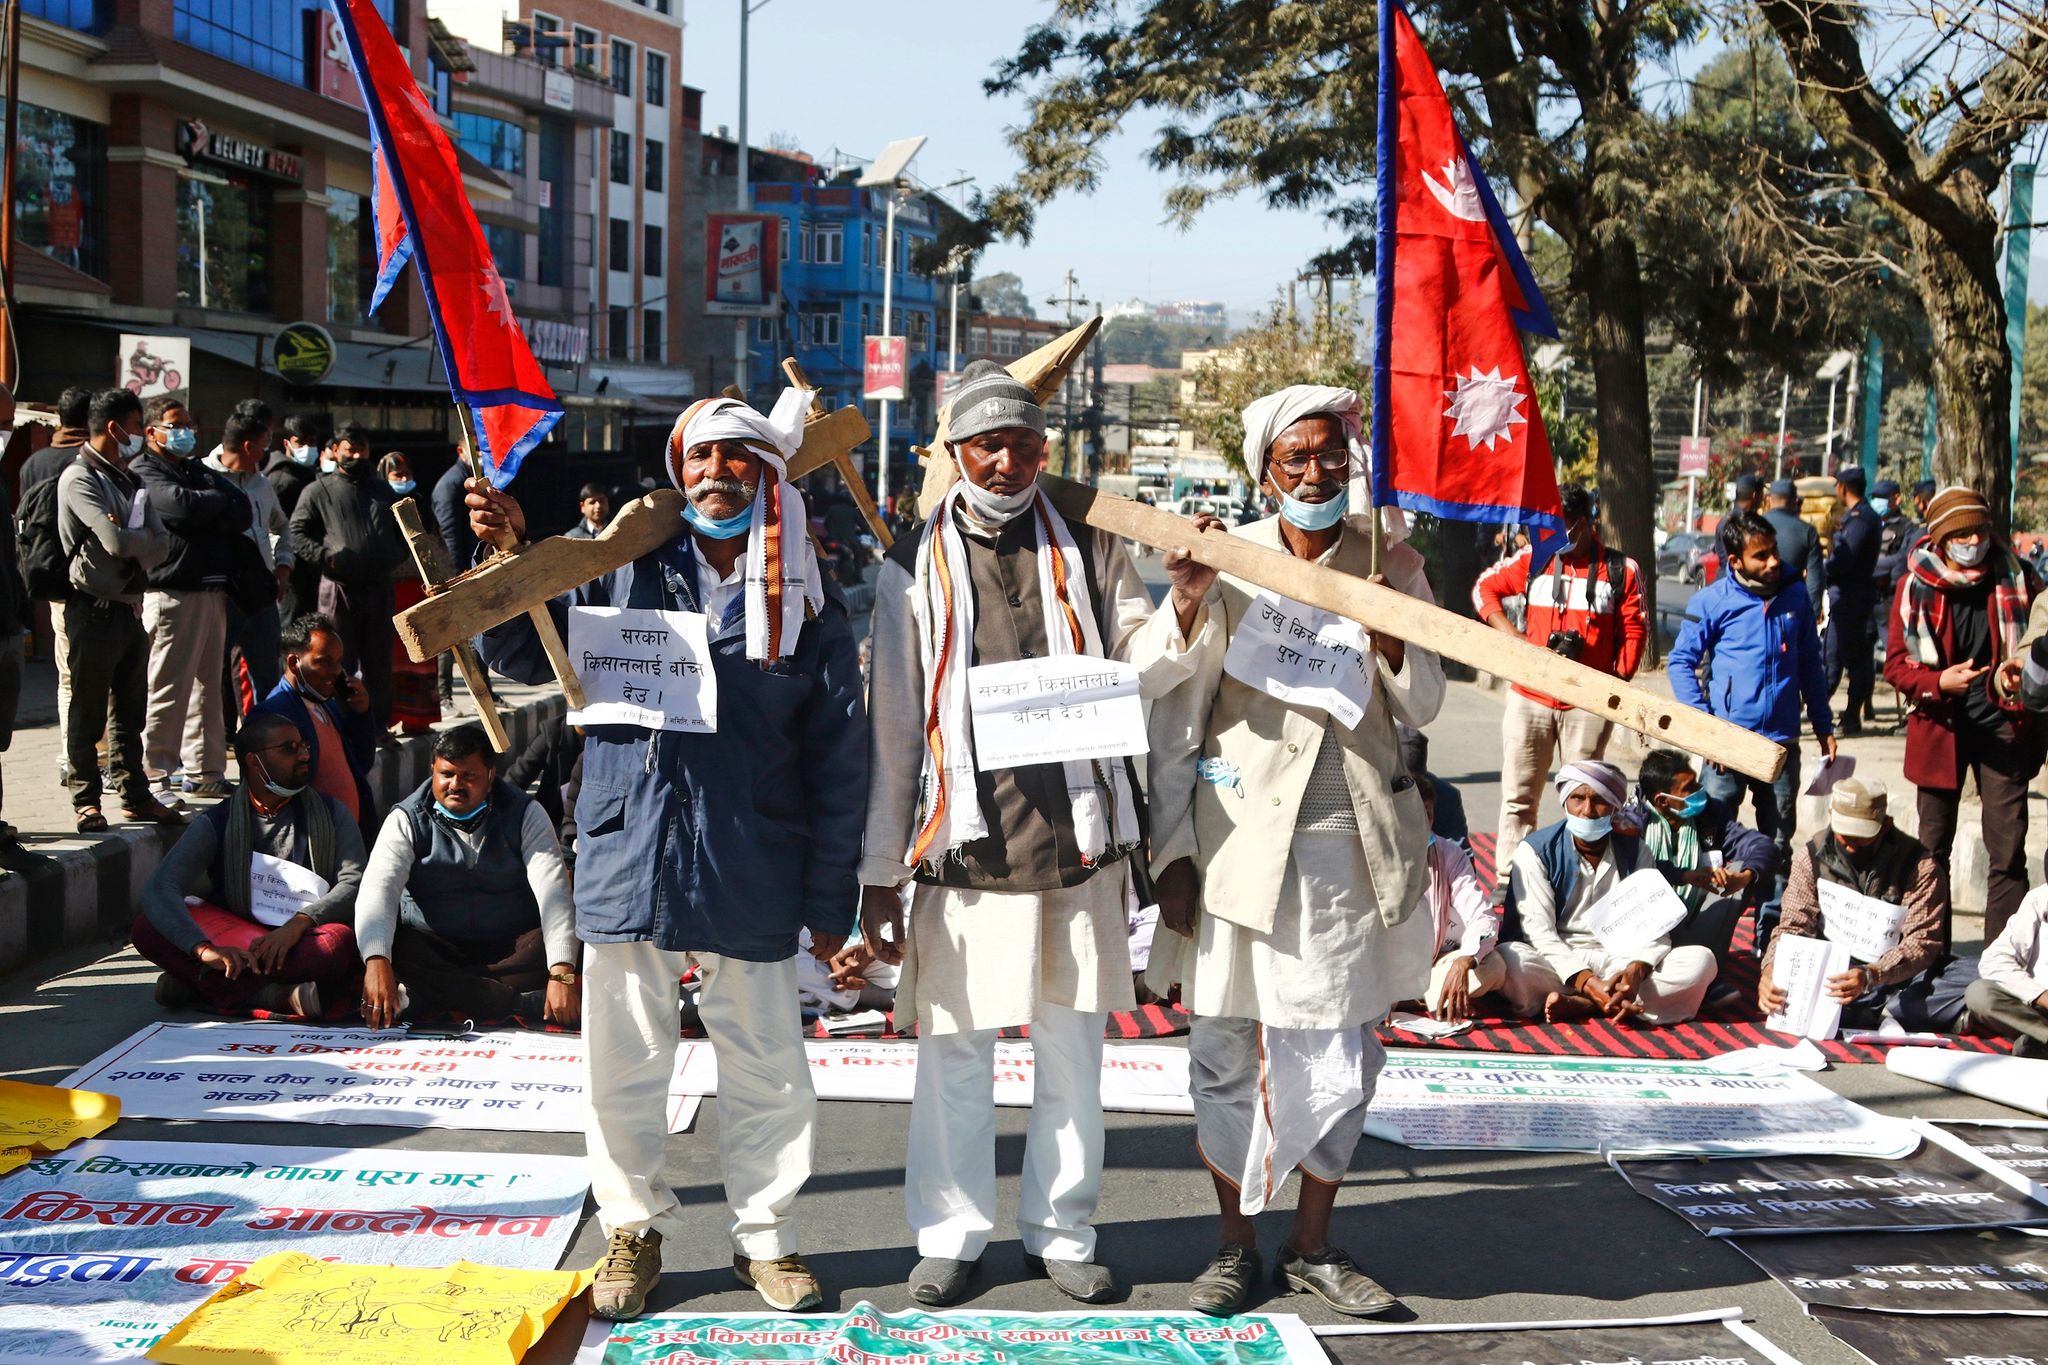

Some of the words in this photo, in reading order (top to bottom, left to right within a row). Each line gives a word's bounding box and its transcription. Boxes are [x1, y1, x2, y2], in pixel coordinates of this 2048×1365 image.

[214, 133, 264, 168] HELMETS
[1262, 603, 1286, 634] उखु
[620, 628, 669, 646] सरकार
[583, 651, 662, 677] किसानलाई
[1277, 643, 1304, 666] पुरा
[1308, 657, 1327, 675] गर
[623, 681, 650, 703] देउ
[978, 681, 1030, 698] सरकार
[1060, 702, 1084, 719] देउ
[218, 1043, 282, 1055] उखु
[288, 1043, 403, 1056] किसान
[107, 1071, 185, 1082] २०७६
[197, 1073, 256, 1084] साल
[263, 1073, 315, 1086] पौष
[371, 1075, 417, 1087] गते
[425, 1077, 500, 1090] नेपाल
[511, 1082, 582, 1094] सरका
[1709, 1077, 1792, 1090] नेपाल
[203, 1089, 284, 1102] भएको
[293, 1092, 406, 1106] सम्झौता
[414, 1096, 474, 1109] लागु
[482, 1098, 525, 1110] गर
[31, 1158, 77, 1176] खु
[74, 1155, 262, 1180] किसानको
[264, 1164, 349, 1183] माग
[355, 1169, 424, 1187] पुरा
[429, 1172, 494, 1188] गर
[0, 1191, 236, 1228] किसान
[245, 1204, 562, 1239] आन्दोलन
[1860, 1277, 1890, 1290] के
[649, 1330, 697, 1345] उखु
[998, 1330, 1071, 1342] रकम
[1080, 1328, 1151, 1342] ब्याज
